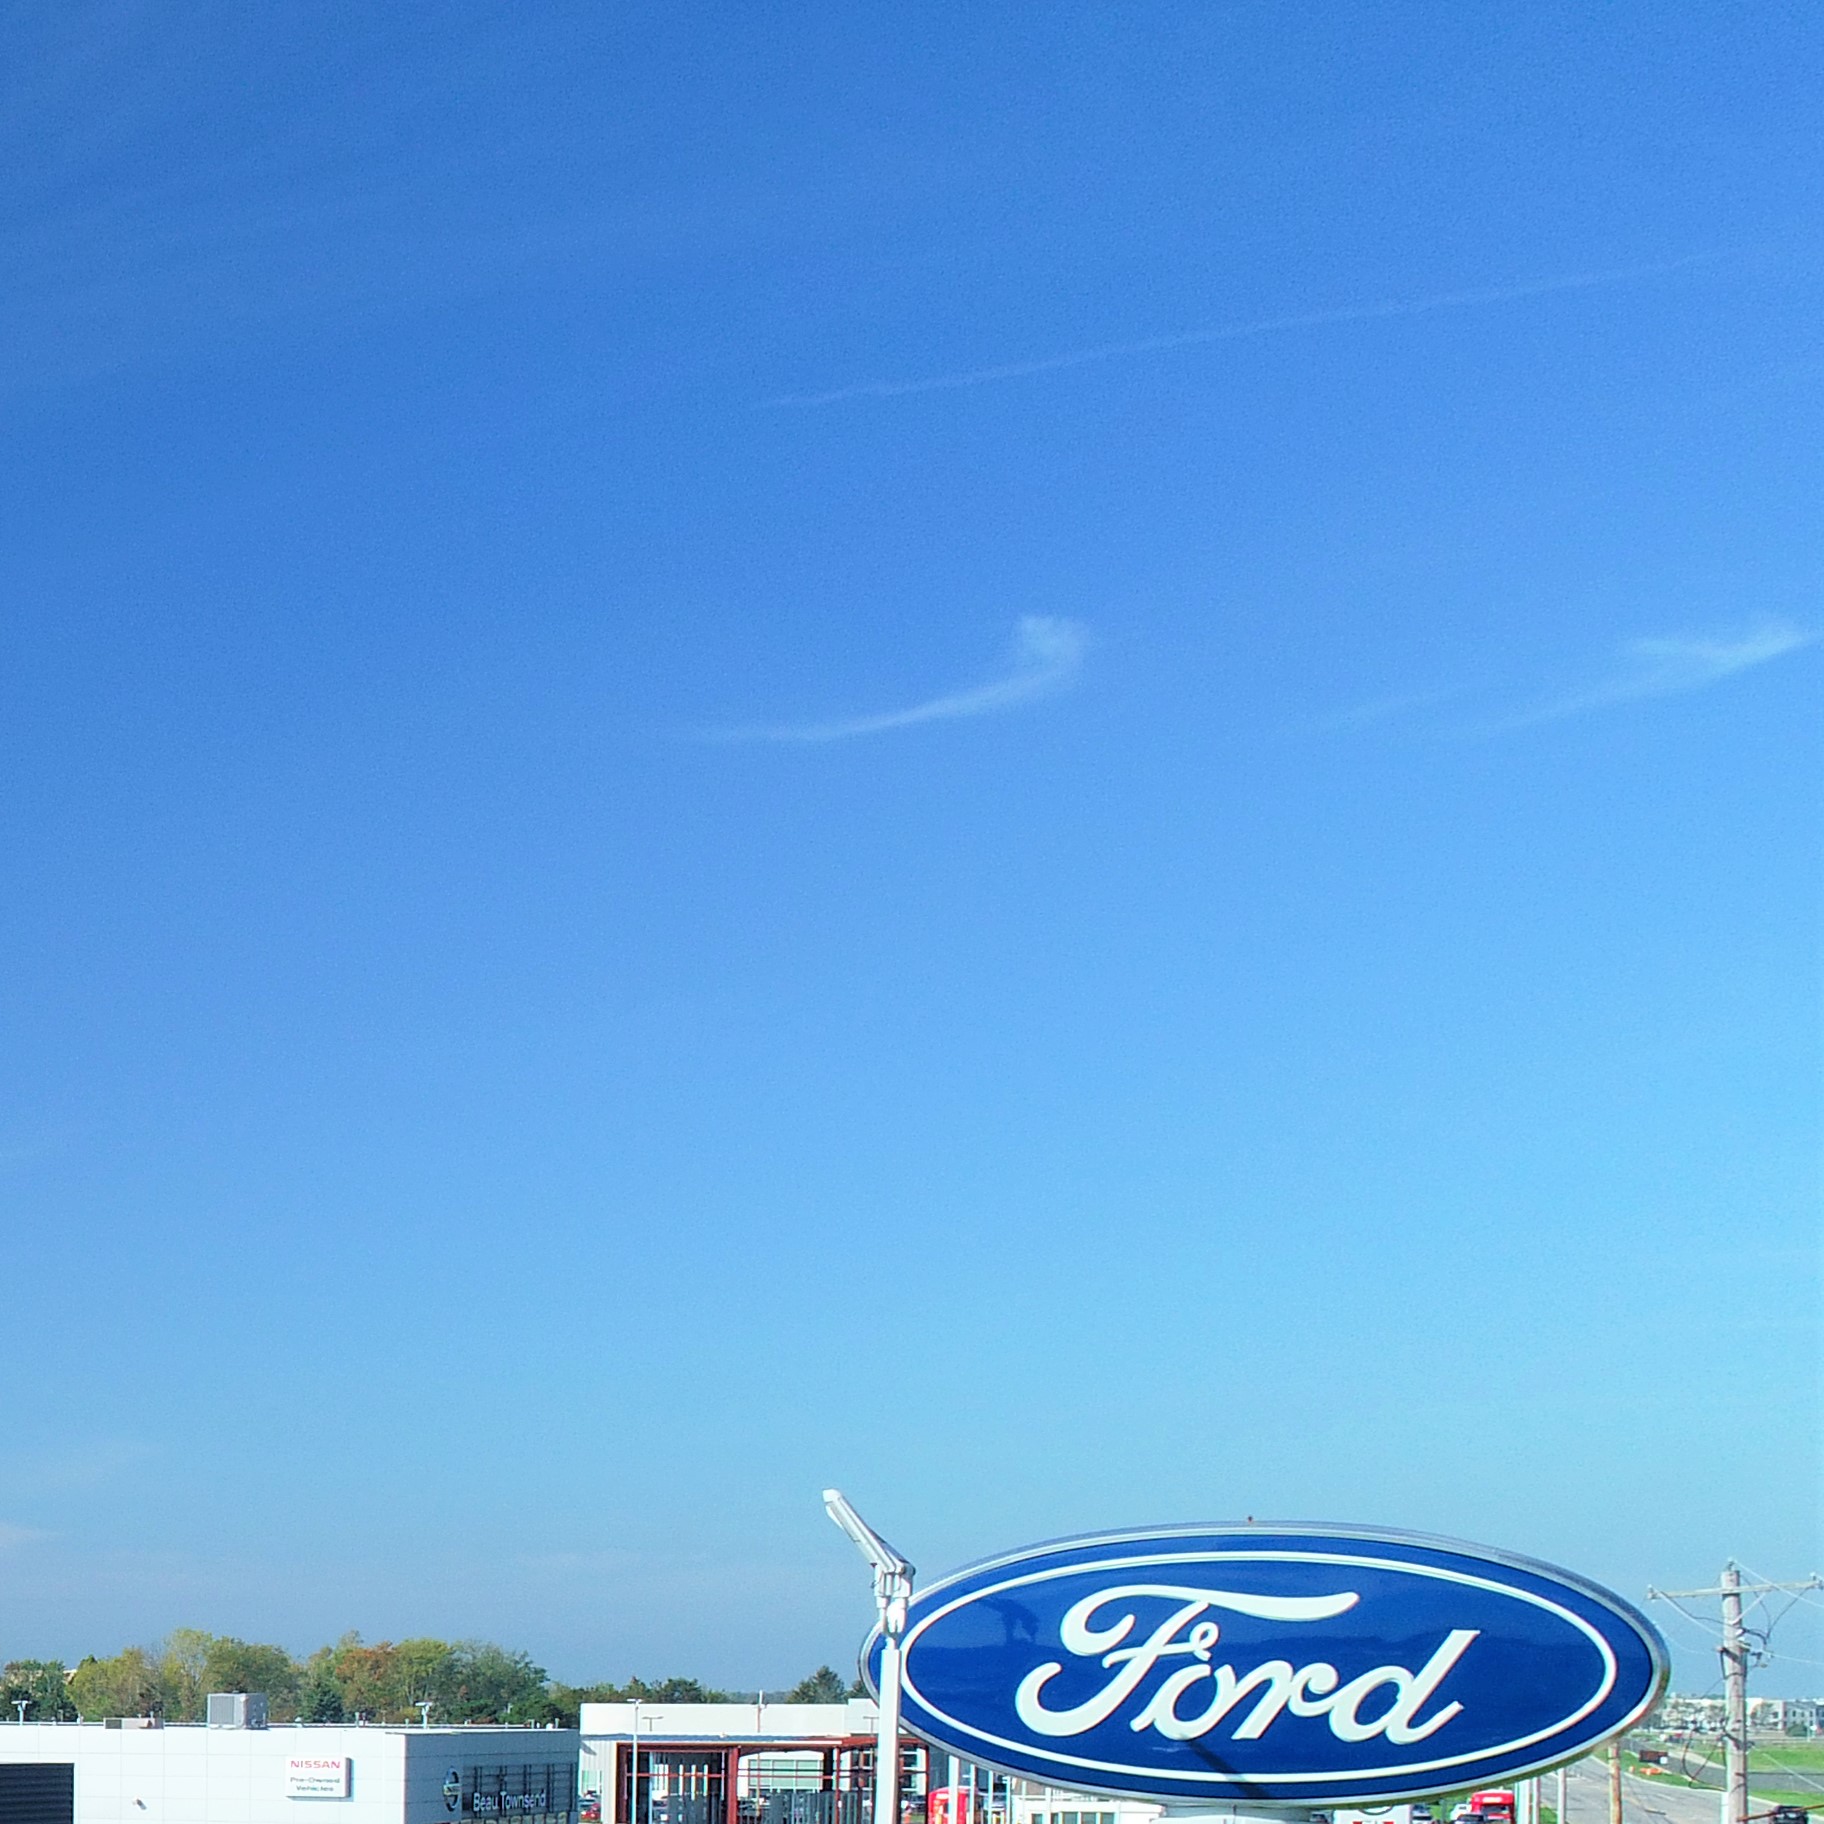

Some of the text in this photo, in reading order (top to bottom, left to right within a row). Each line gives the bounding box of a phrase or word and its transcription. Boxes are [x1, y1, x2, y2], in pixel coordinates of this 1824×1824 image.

[1014, 1584, 1481, 1745] Ford
[290, 1760, 341, 1769] NISSAN
[473, 1789, 547, 1811] Beau Townsend
